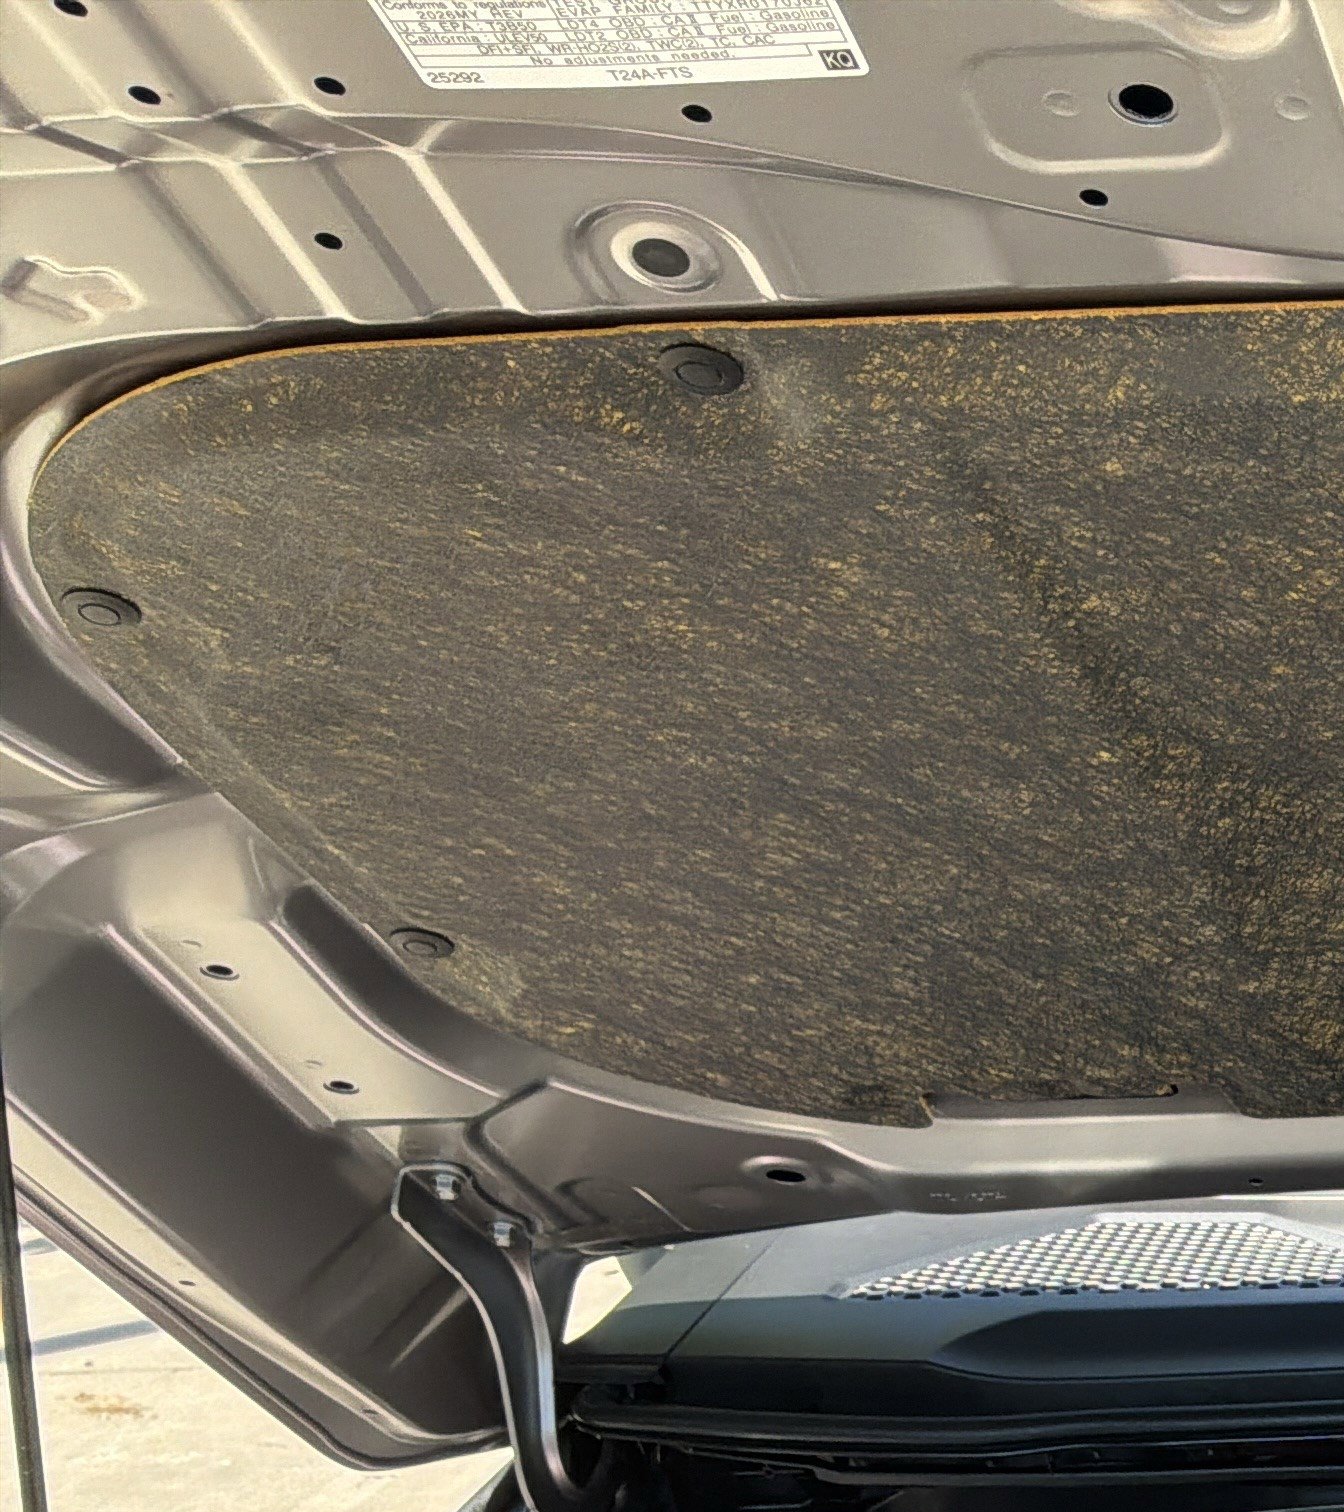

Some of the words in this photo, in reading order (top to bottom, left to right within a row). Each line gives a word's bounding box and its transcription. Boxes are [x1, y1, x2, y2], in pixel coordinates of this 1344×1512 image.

[417, 9, 478, 19] 2026MY
[490, 8, 523, 18] HEV
[556, 6, 602, 17] EVAP
[612, 3, 673, 15] FAMILY
[557, 18, 600, 30] LDT4
[609, 16, 646, 28] OBD
[709, 10, 747, 24] Fuel
[759, 8, 830, 21] Gasoline
[565, 30, 608, 42] LDT2
[616, 28, 653, 40] OBD
[716, 22, 752, 35] Fuel
[765, 19, 837, 33] Gasoline
[404, 32, 481, 45] California
[741, 34, 776, 47] CAC
[529, 55, 554, 66] No
[564, 53, 661, 66] adjustments
[824, 51, 858, 69] KQ
[426, 72, 486, 84] 25292
[607, 66, 695, 83] T24A-FTS
